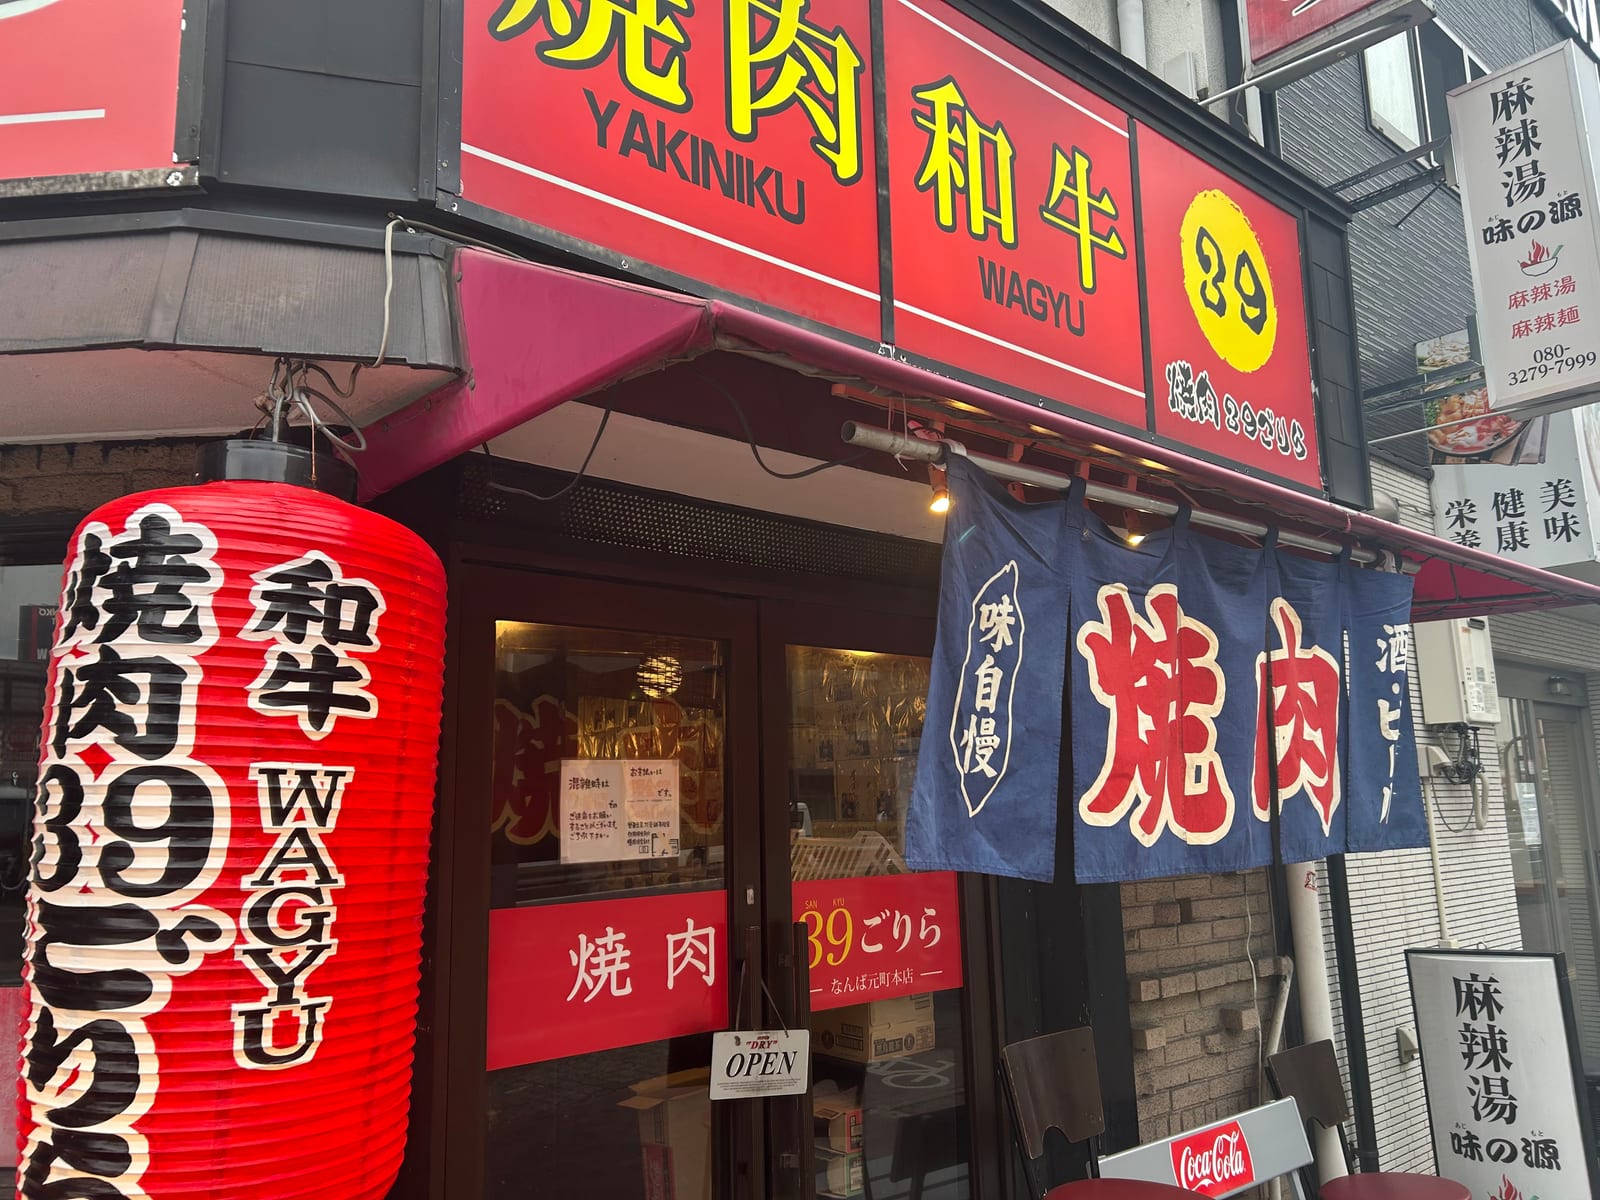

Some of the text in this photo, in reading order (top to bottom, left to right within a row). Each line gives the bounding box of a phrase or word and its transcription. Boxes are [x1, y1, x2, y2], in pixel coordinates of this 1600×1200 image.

[1490, 76, 1547, 207] 麻辣湯
[582, 87, 1086, 337] YAKINIKU WAGYU
[911, 75, 1127, 295] 和牛
[1482, 192, 1583, 245] 味の源
[1196, 226, 1268, 335] 39
[1508, 275, 1576, 310] 麻辣湯
[1508, 351, 1597, 386] 3279-7999
[1533, 344, 1570, 364] 080-
[1165, 360, 1220, 430] 焼肉
[1491, 488, 1530, 553] 健康
[1539, 478, 1582, 543] 美味
[239, 549, 386, 742] 和牛
[960, 593, 1017, 780] 味自慢
[1076, 582, 1342, 848] 焼肉
[569, 777, 610, 790] 混雑時は
[232, 762, 356, 1071] WAGYU
[805, 898, 845, 910] SAN KYU
[566, 918, 717, 1004] 焼肉
[831, 968, 914, 995] なんば元町本店
[726, 1051, 798, 1078] OPEN
[1452, 973, 1518, 1125] 麻辣湯
[1180, 1130, 1247, 1191] Coca-Cola
[1450, 1131, 1561, 1171] 味の源
